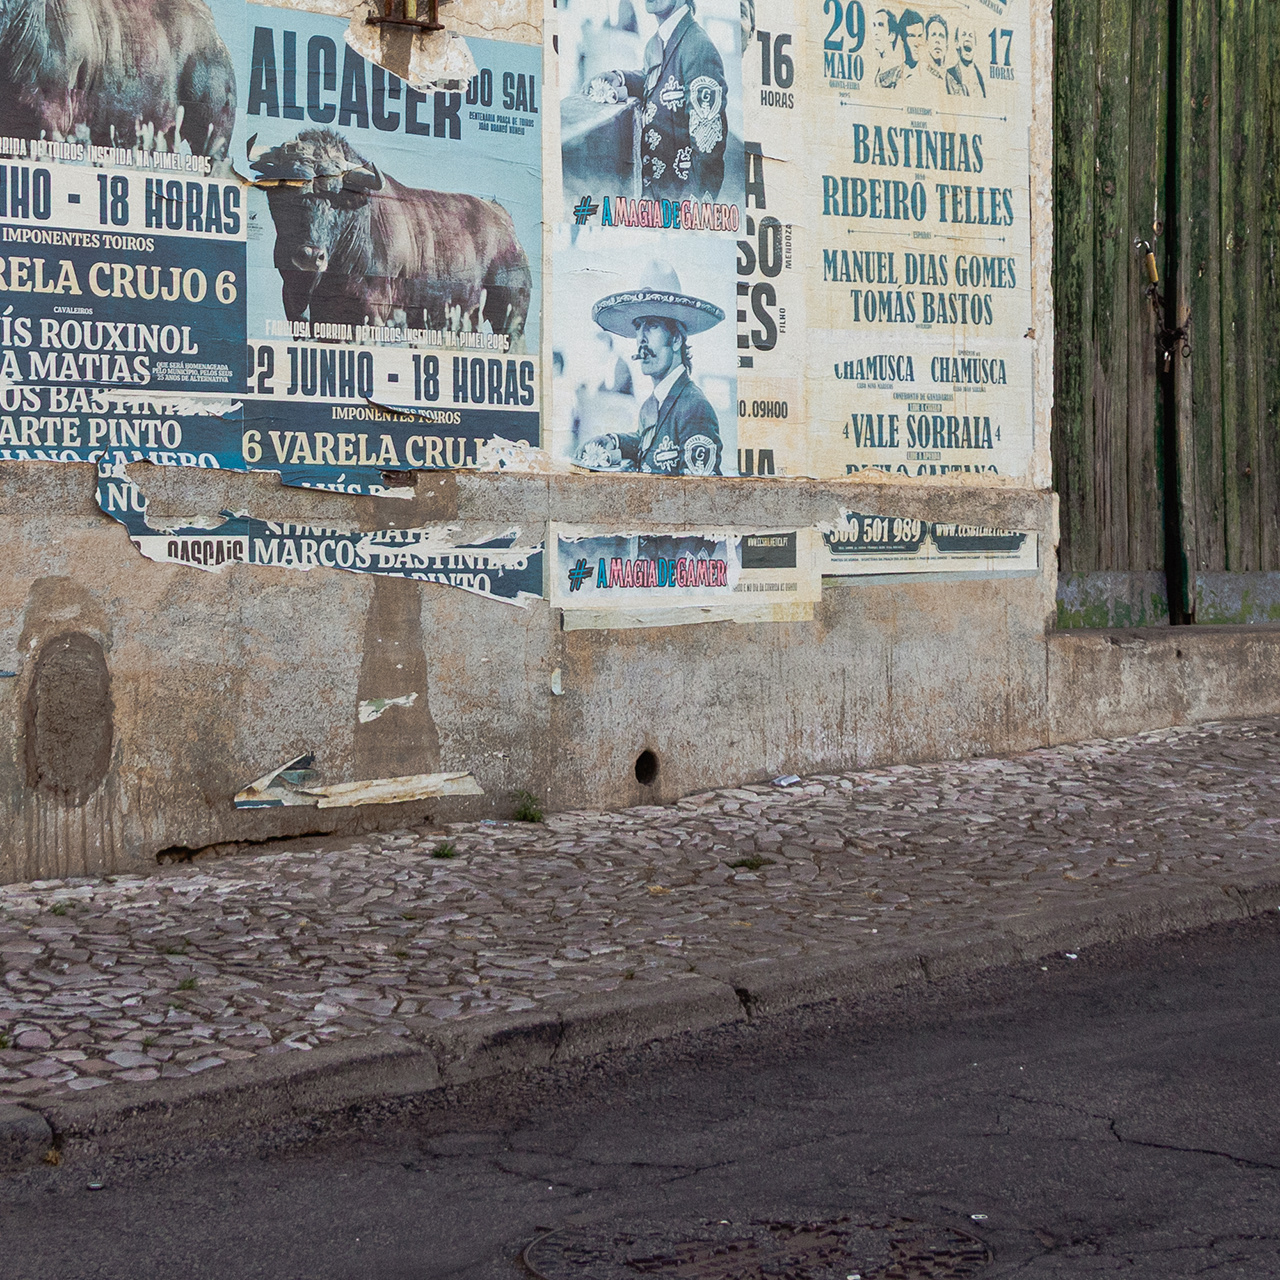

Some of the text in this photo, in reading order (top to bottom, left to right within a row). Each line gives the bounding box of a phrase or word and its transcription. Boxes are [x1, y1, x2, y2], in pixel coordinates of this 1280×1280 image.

[756, 29, 794, 89] 16
[988, 26, 1014, 67] 17
[823, 51, 865, 81] MAIO
[989, 64, 1015, 81] HORAS
[502, 71, 539, 114] SAL
[760, 89, 794, 110] HORAS
[46, 140, 84, 161] TOIROS
[852, 123, 983, 174] BASTINHAS
[97, 173, 130, 226] 18
[145, 177, 242, 235] HORAS
[822, 175, 1014, 227] RIBEIRO TELLES
[1, 227, 155, 252] IMPONENTES TOIROS
[88, 262, 207, 303] CRUJO
[215, 270, 237, 304] 6
[822, 249, 1016, 289] MANUEL DIAS GOMES
[53, 305, 93, 316] CAVALEIROS
[779, 307, 787, 334] FILHO
[850, 285, 993, 327] TOMÁS BASTOS
[39, 317, 199, 355] ROUXINOL
[314, 323, 352, 341] CORRIDA
[27, 350, 151, 386] MATIAS
[287, 346, 374, 398] JUNHO
[412, 354, 440, 402] 18
[453, 356, 535, 406] HORAS
[931, 356, 1007, 385] CHAMUSCA
[738, 399, 788, 419] 0.09H00
[87, 419, 182, 449] PINTO
[242, 429, 482, 469] 6 VARELA CRUJ
[842, 413, 1001, 449] 4 VALE SORRAIA 4
[863, 517, 889, 543] 501
[893, 518, 921, 543] 989
[253, 537, 372, 568] MARCOS
